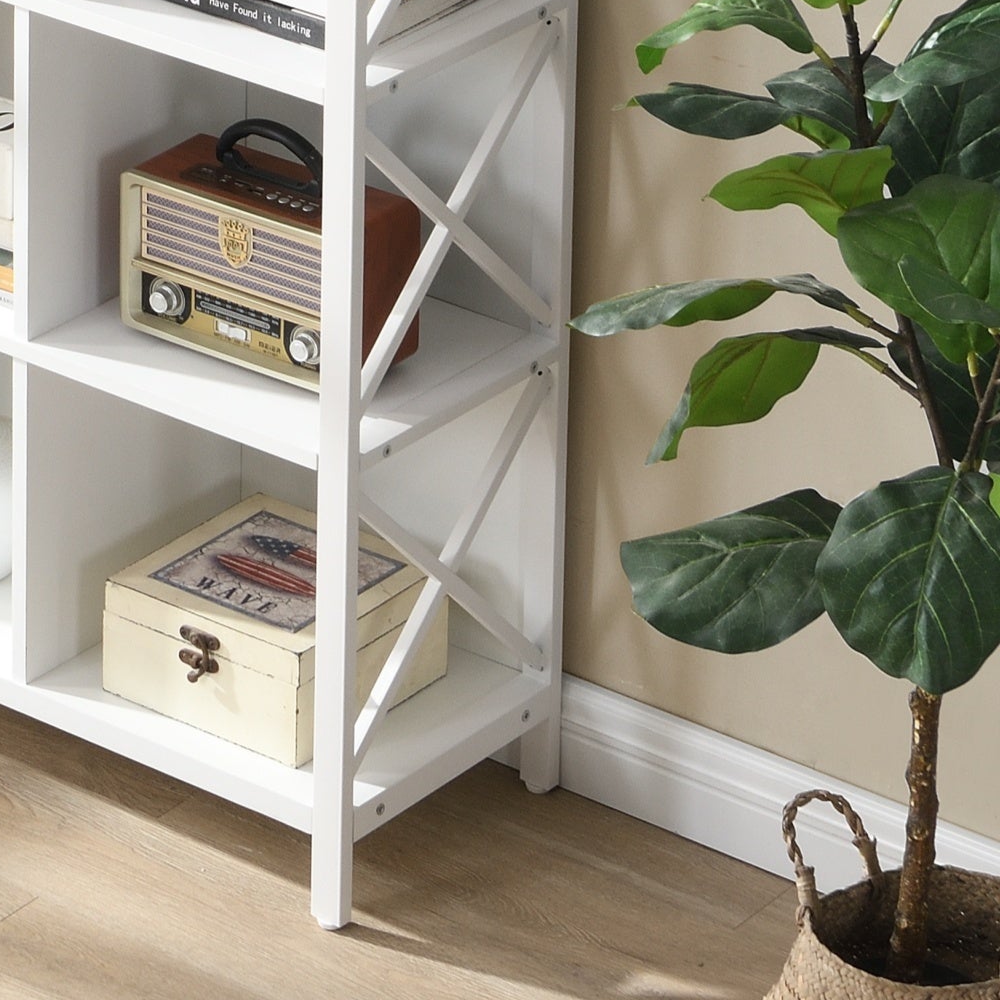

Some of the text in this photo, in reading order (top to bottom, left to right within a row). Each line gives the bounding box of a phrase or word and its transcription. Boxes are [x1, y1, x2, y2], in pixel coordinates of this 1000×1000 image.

[232, 2, 259, 20] Found
[262, 12, 273, 25] it
[277, 16, 312, 38] lacking
[196, 576, 279, 615] WAVE
